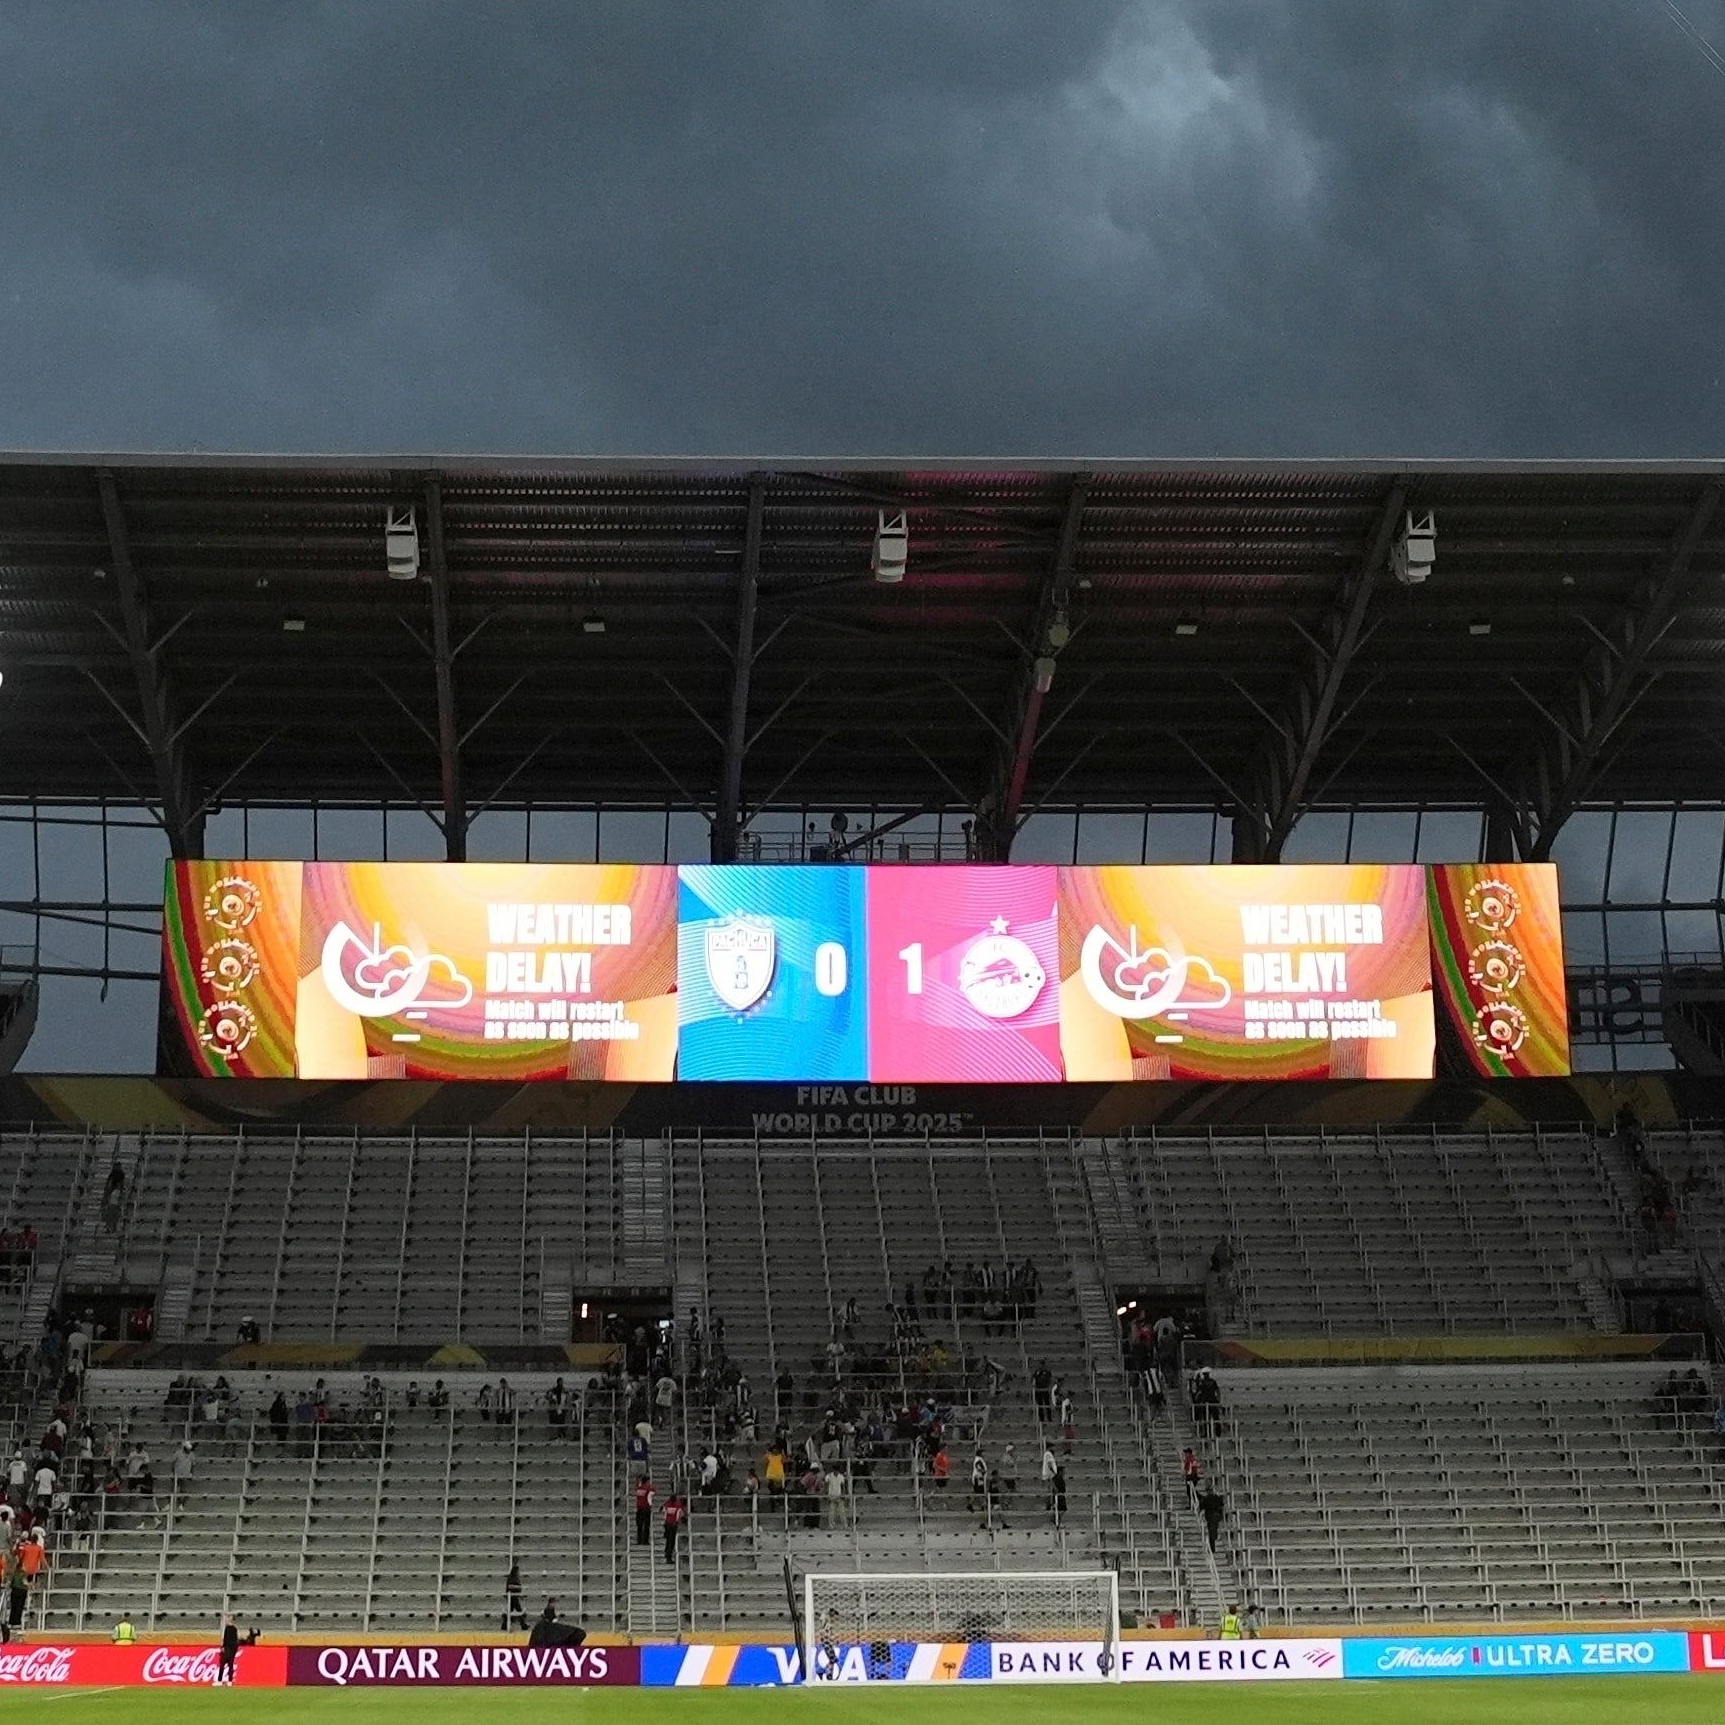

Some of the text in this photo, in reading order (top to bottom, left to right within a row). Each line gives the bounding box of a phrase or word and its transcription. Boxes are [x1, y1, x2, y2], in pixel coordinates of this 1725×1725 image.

[487, 904, 632, 945] WEATHER
[1240, 904, 1383, 945] WEATHER
[486, 952, 592, 993] DELAY!
[815, 941, 847, 997] 0
[898, 942, 923, 995] 1
[1242, 952, 1348, 993] DELAY!
[485, 998, 625, 1020] Match will restart
[1244, 998, 1382, 1019] Match will restart
[484, 1020, 640, 1042] as soon as possible
[1244, 1019, 1397, 1041] as soon as possible
[797, 1086, 916, 1106] FIFA CLUB
[752, 1113, 841, 1133] WORLD
[847, 1113, 895, 1133] CUP
[318, 1648, 608, 1685] QATAR AIRWAYS
[999, 1649, 1291, 1674] BANK OF AMERICA
[1377, 1641, 1655, 1671] Michelob ULTRA ZERO
